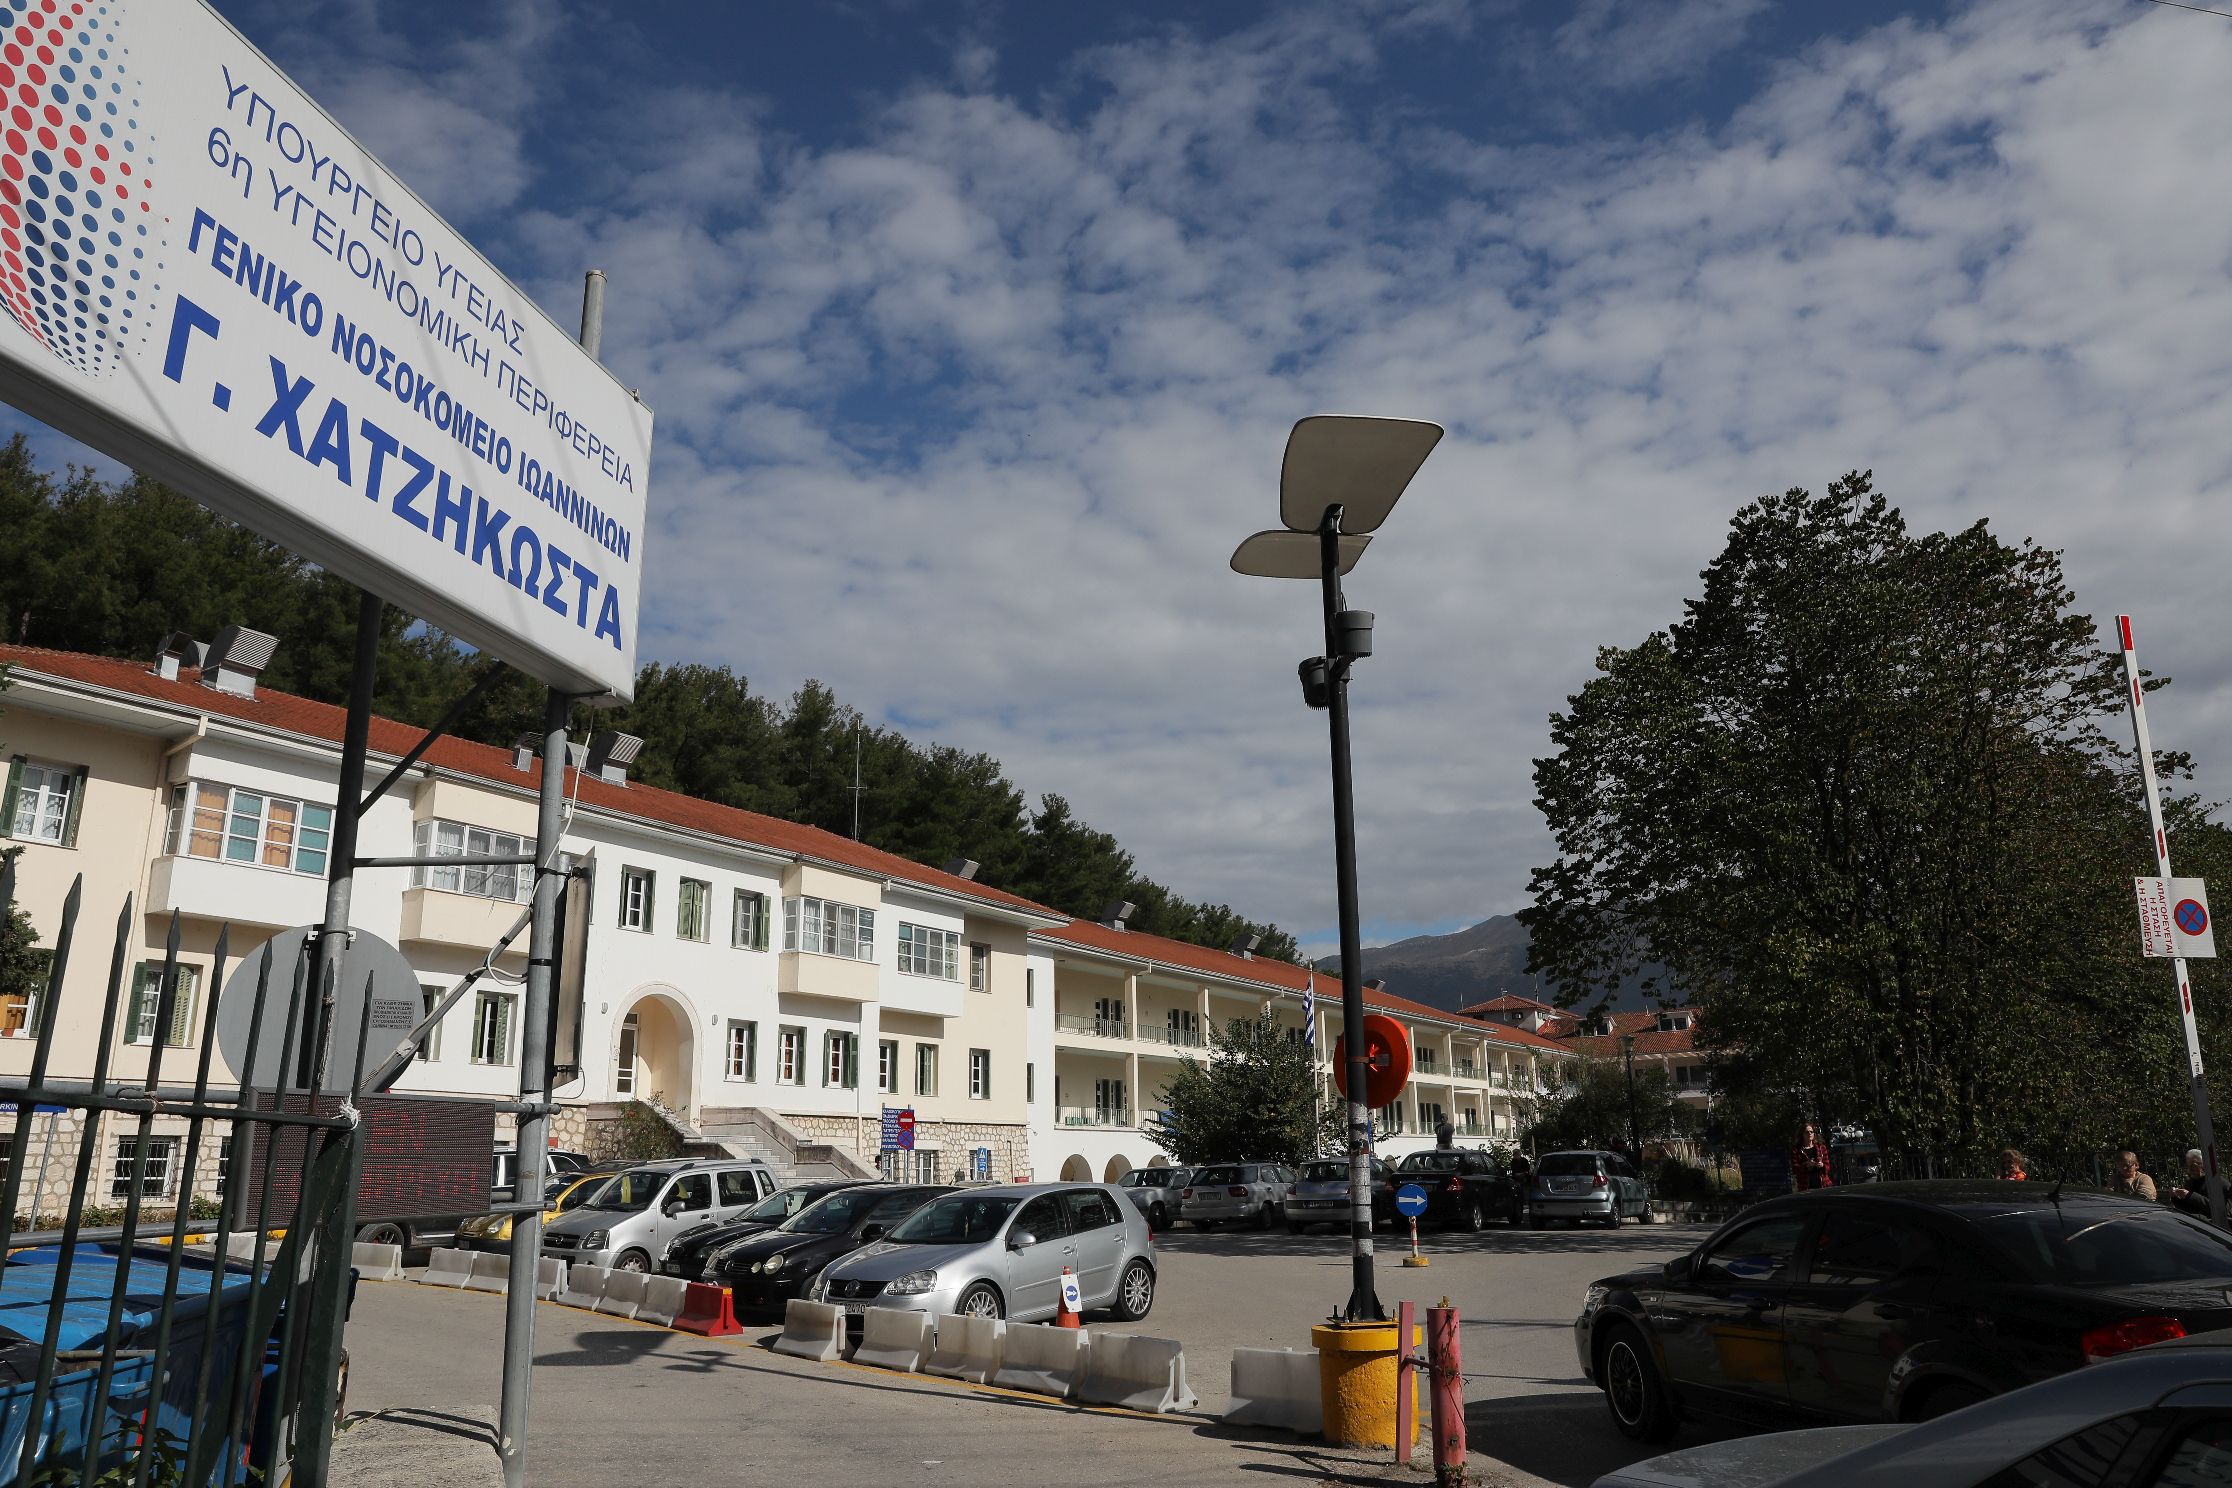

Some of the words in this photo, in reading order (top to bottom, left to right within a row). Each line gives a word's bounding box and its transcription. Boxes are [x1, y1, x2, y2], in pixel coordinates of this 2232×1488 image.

[208, 127, 253, 198] 6η
[268, 168, 489, 378] ΥΓΕΙΟΝΟΜΙΚΗ
[498, 360, 634, 494] ΠΕΡΙΦΕΡΕΙΑ
[221, 65, 424, 267] ΥΠΟΥΡΓΕΙΟ
[434, 251, 525, 358] ΥΓΕΙΑΣ
[163, 294, 232, 412] Γ.
[255, 356, 622, 650] ΧΑΤΖΗΚΩΣΤΑ
[188, 207, 324, 337] ΓΕΝΙΚΟ
[332, 314, 512, 475] ΝΟΣΟΚΟΜΕΙΟ
[517, 452, 631, 563] ΙΩΑΝΝΙΝΩΝ
[2140, 897, 2153, 956] ΣΤΑΘΜΕΥΣΗ
[2150, 907, 2162, 937] ΣΤΑΣΗ
[2156, 881, 2174, 954] ΑΠΑΓΟΡΕΥΕΤΑΙ
